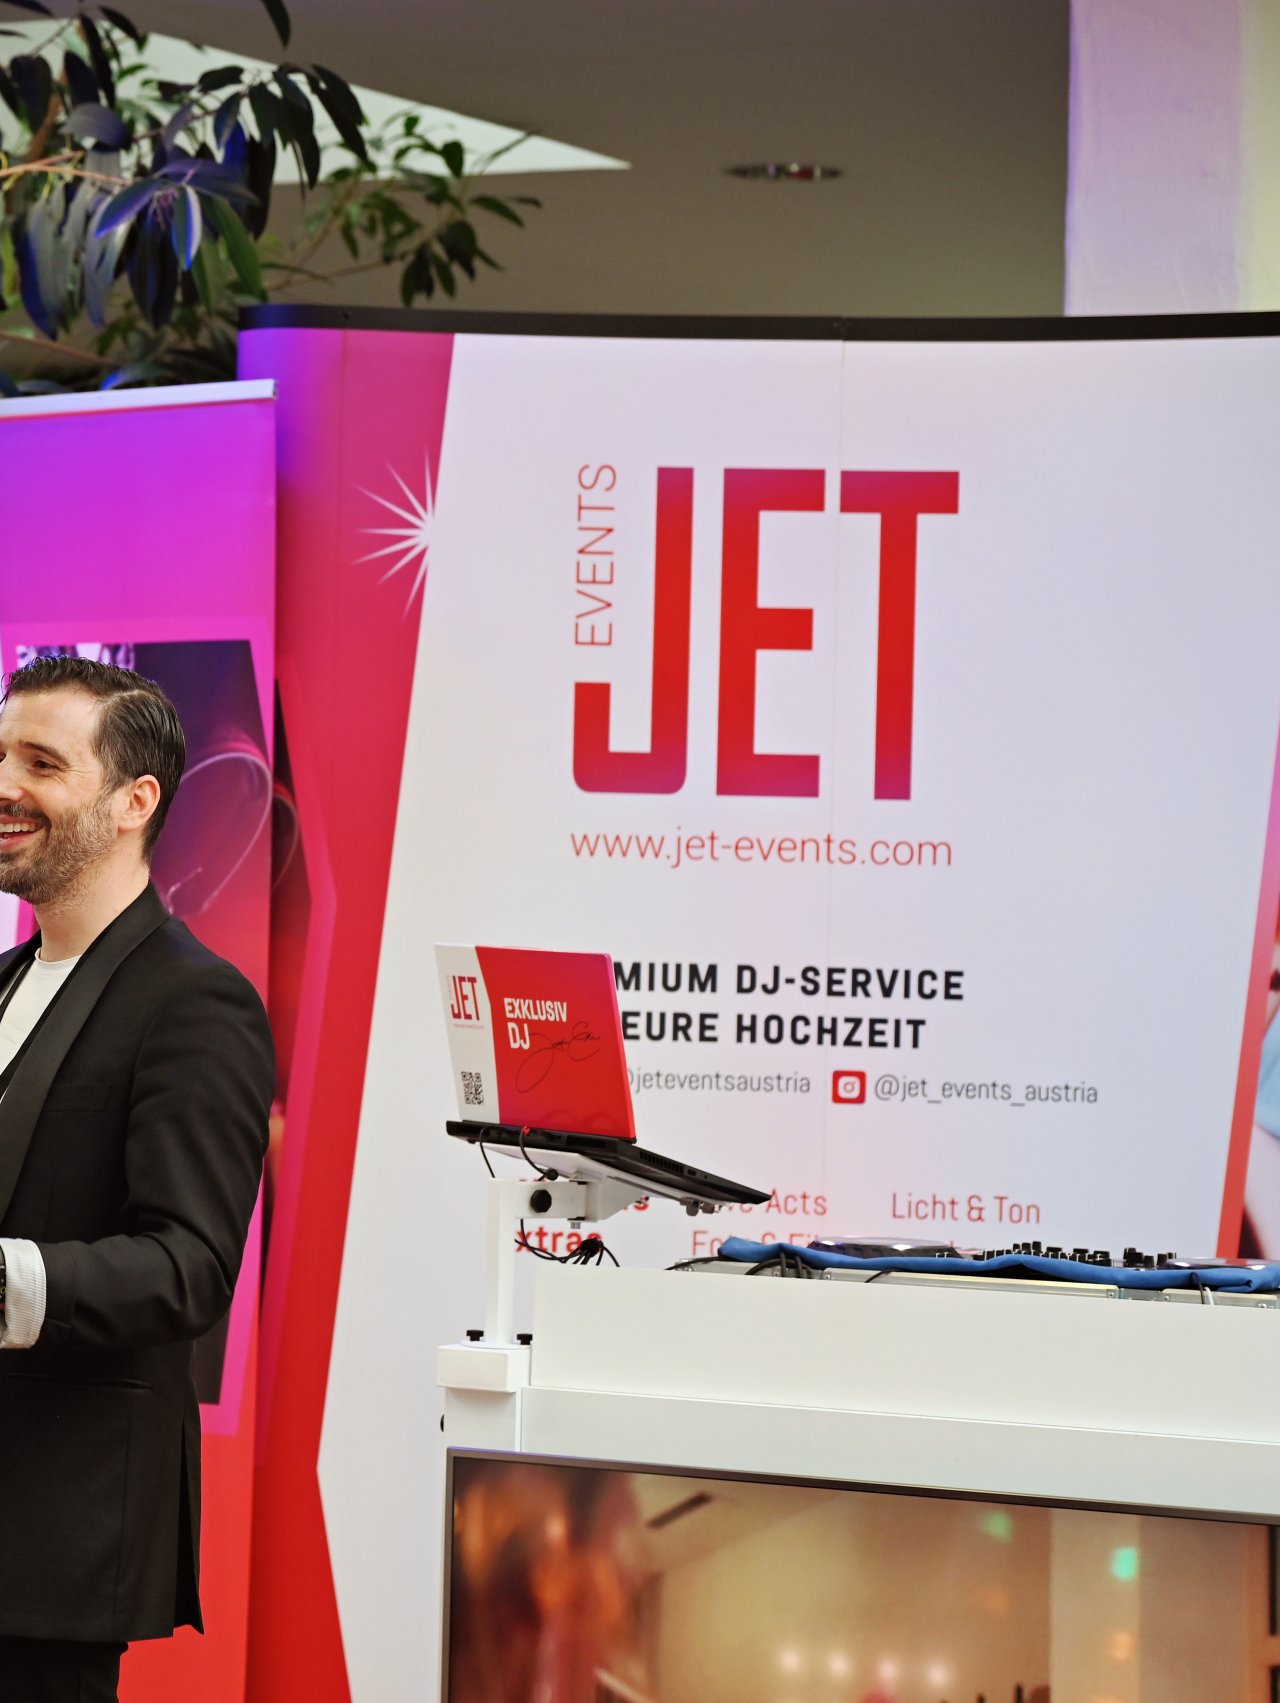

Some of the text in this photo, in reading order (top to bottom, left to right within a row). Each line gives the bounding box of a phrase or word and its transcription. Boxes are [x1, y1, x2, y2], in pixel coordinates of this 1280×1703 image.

[575, 464, 616, 646] EVENTS
[573, 467, 960, 801] JET
[571, 827, 953, 869] www.jet-events.com
[450, 975, 481, 1021] JET
[613, 961, 966, 1001] MIUM DJ-SERVICE
[504, 997, 567, 1022] EXKLUSIV
[507, 1021, 531, 1050] DJ
[621, 1011, 928, 1049] EURE HOCHZEIT
[874, 1073, 1099, 1107] @jet_events_austria
[765, 1187, 828, 1216] Acts
[892, 1192, 959, 1221] Licht
[967, 1194, 986, 1223] &
[994, 1196, 1041, 1225] Ton
